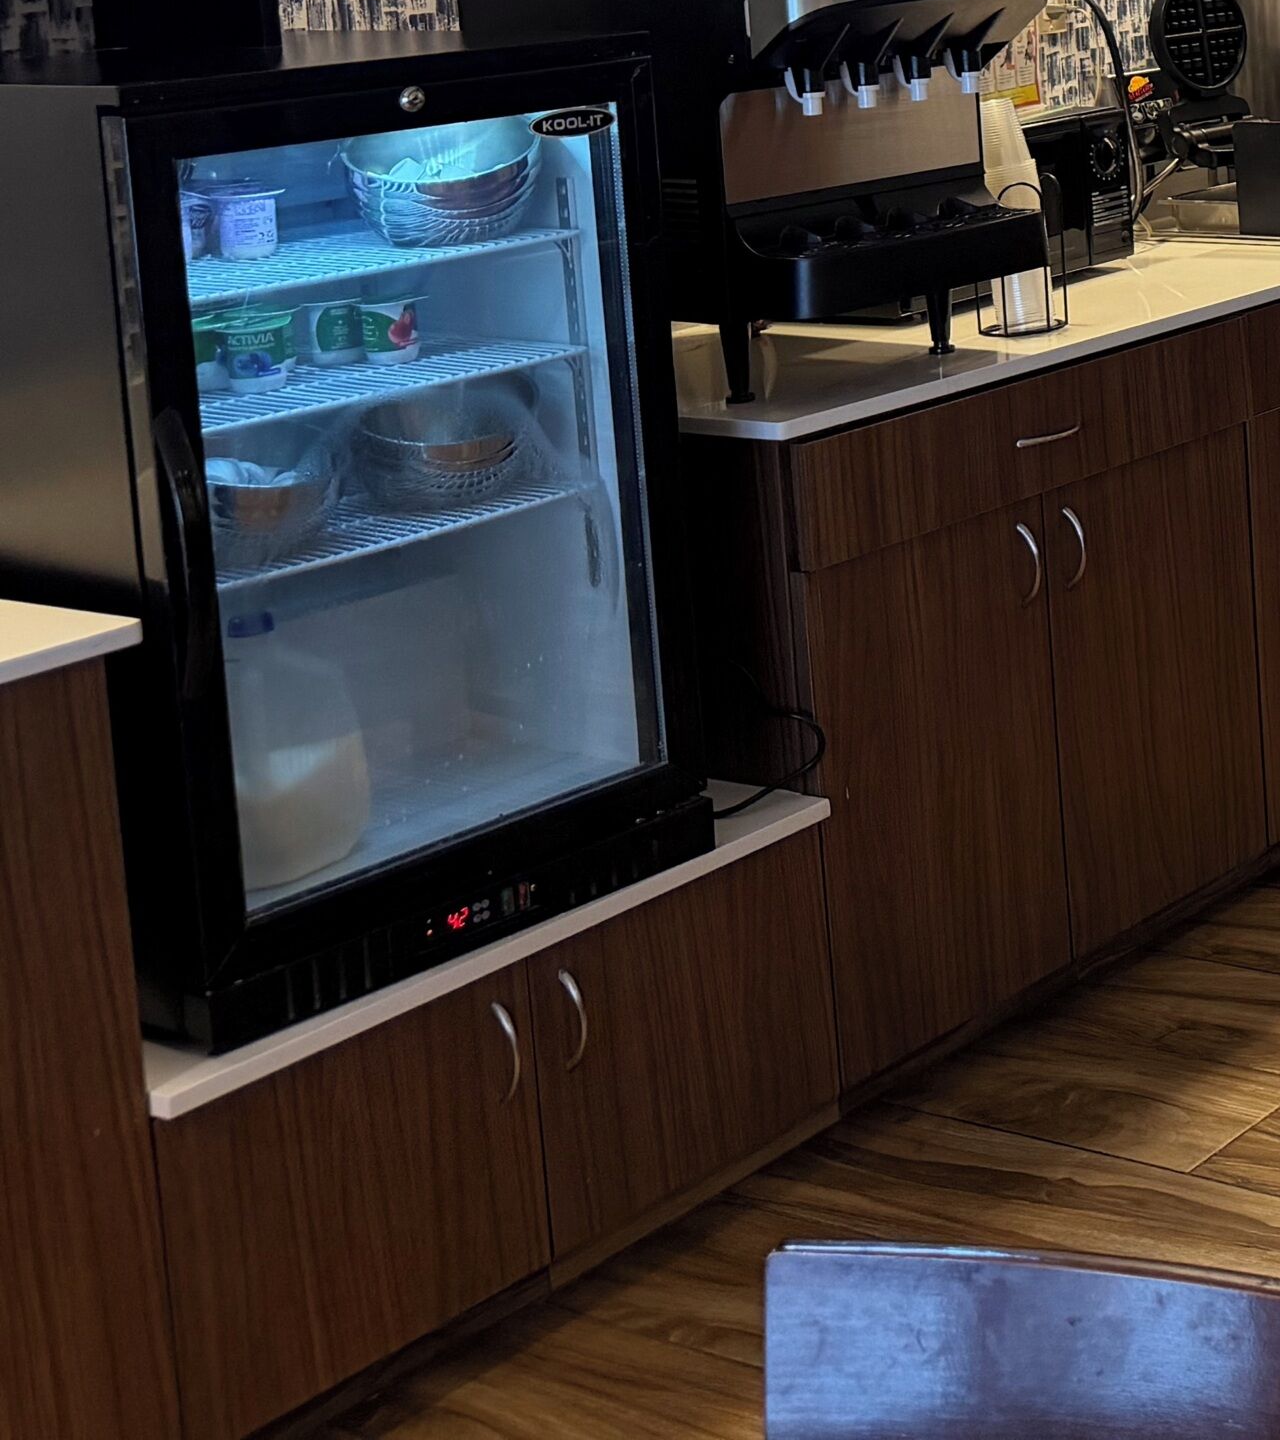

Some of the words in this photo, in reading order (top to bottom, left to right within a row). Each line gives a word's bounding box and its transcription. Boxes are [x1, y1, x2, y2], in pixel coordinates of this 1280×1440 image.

[542, 114, 604, 133] KOOL-IT
[227, 331, 275, 346] ACTIVIA
[447, 906, 469, 929] 42
